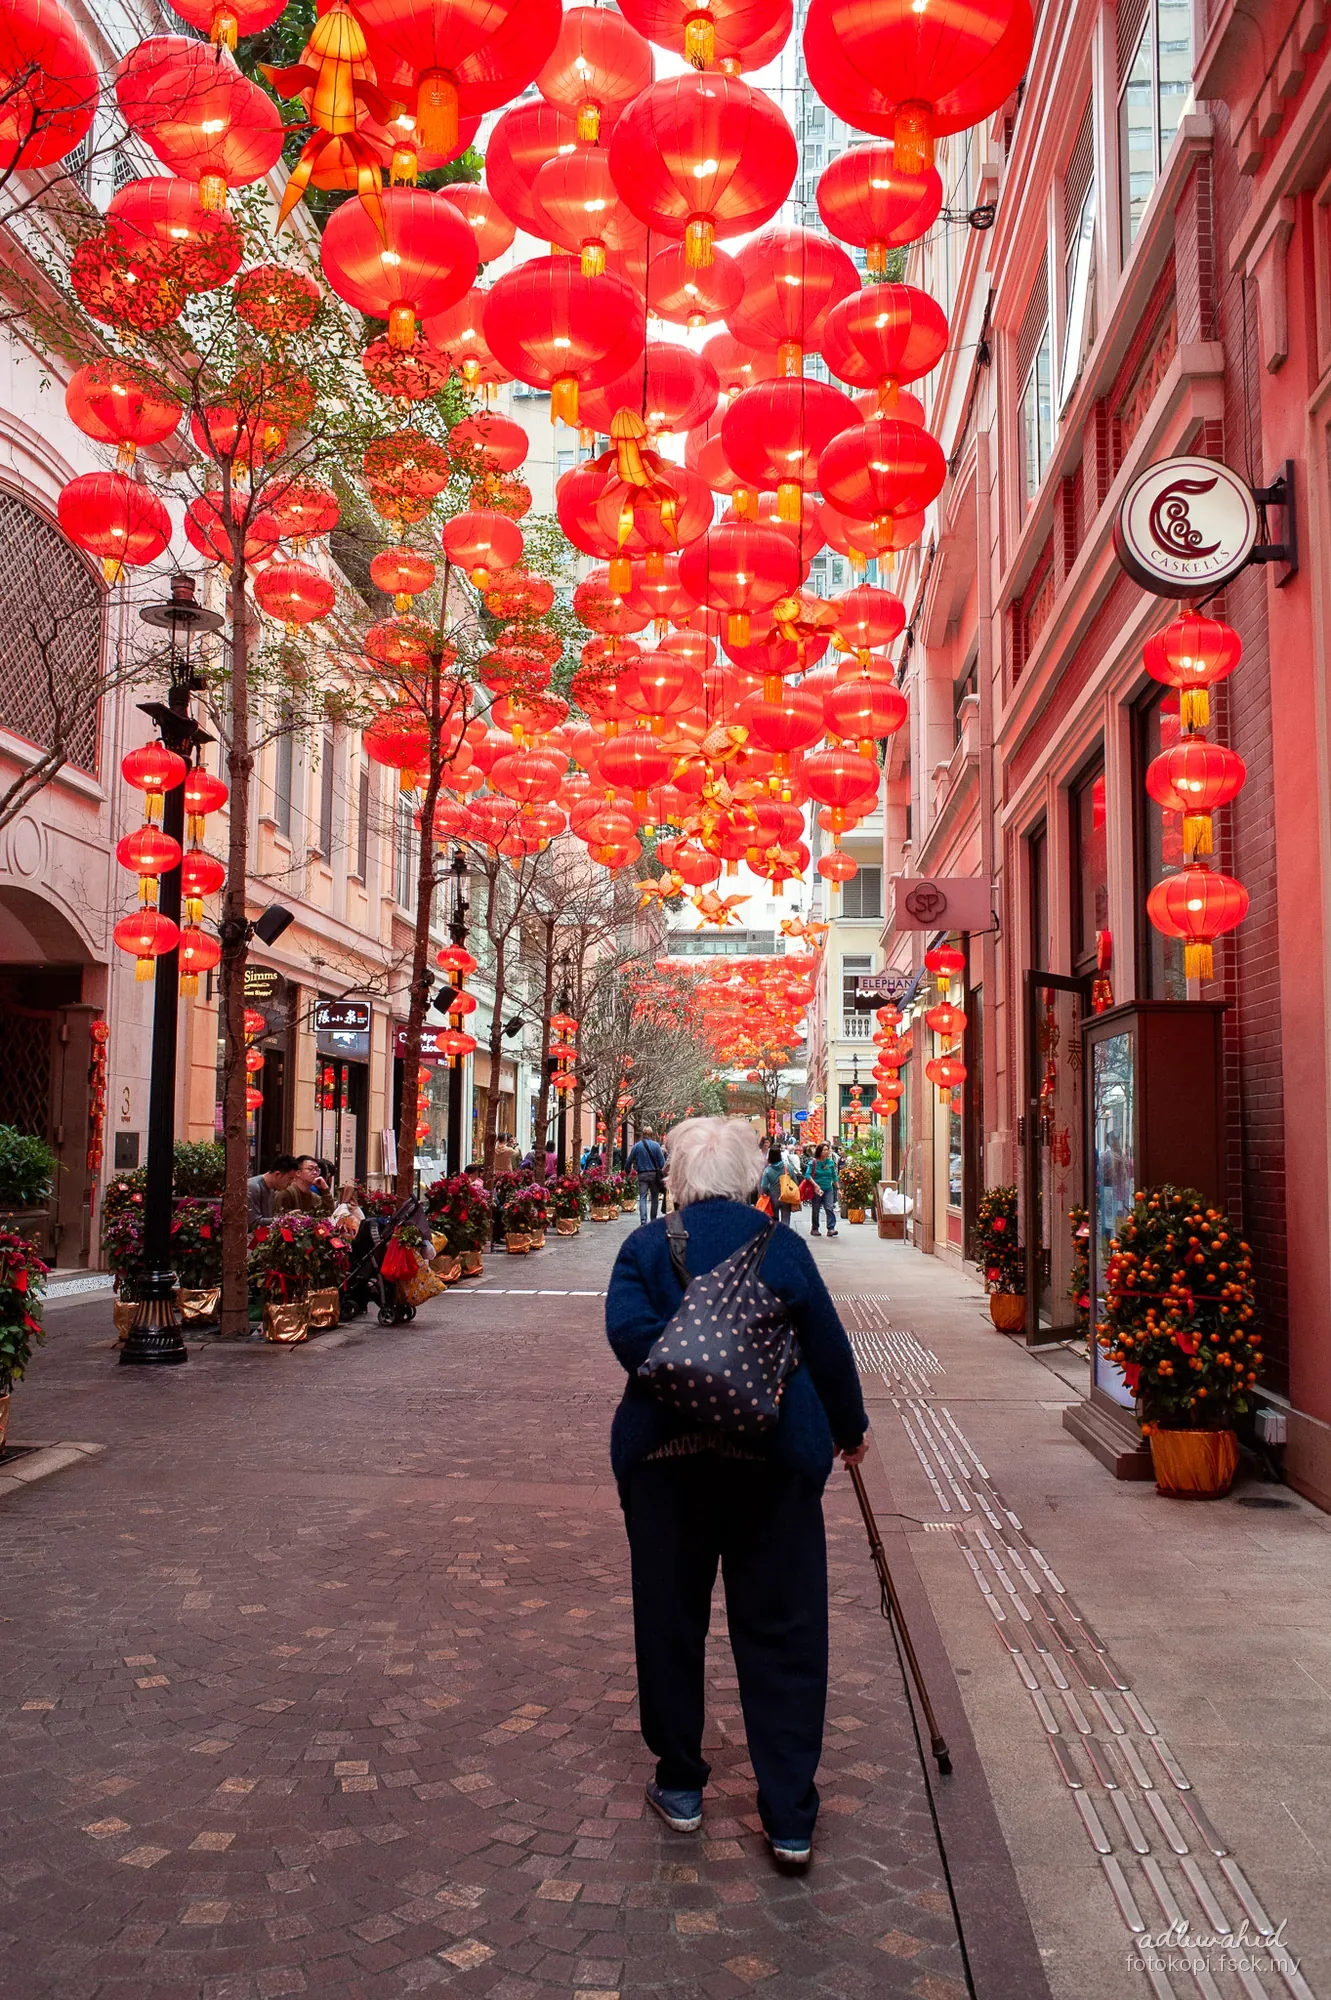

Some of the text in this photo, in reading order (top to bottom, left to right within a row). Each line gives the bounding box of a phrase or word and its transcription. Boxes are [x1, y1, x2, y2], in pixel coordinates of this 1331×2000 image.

[1150, 550, 1230, 574] CASKELLS
[915, 894, 938, 912] SP
[244, 970, 278, 983] Simms
[863, 979, 913, 988] ELEPHAN
[121, 1086, 130, 1115] 3
